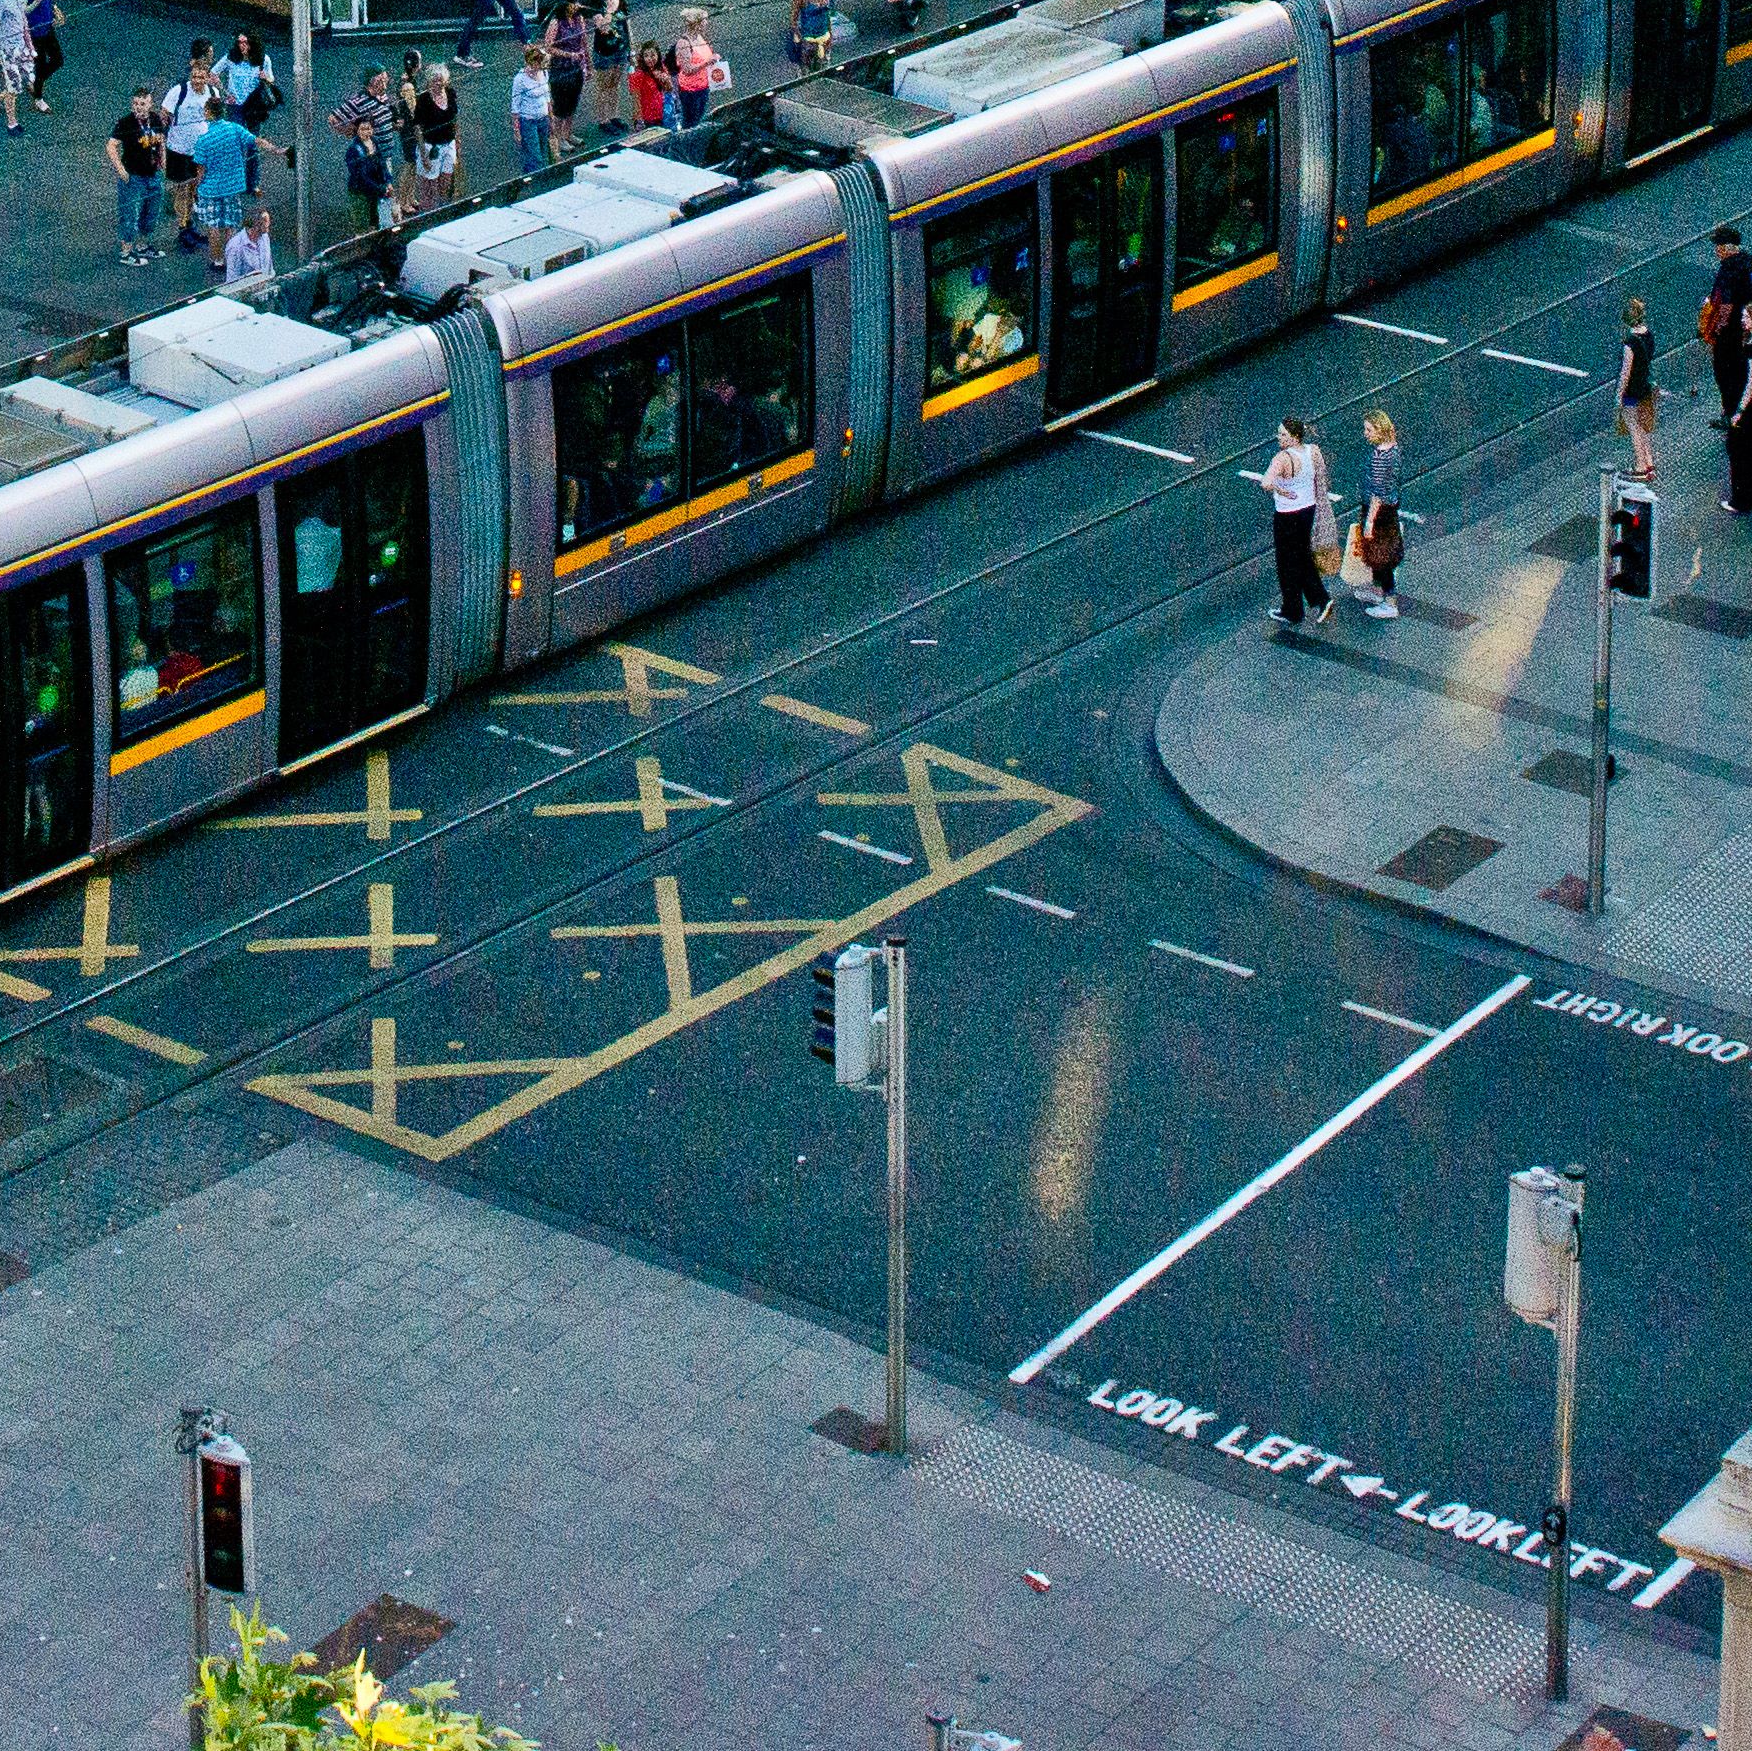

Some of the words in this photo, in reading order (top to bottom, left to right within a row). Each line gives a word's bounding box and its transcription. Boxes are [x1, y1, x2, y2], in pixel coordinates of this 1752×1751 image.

[1533, 990, 1667, 1036] RIGHT
[1087, 1379, 1218, 1439] LOOK
[1214, 1425, 1353, 1485] LEFT
[1395, 1490, 1527, 1552] LOOK
